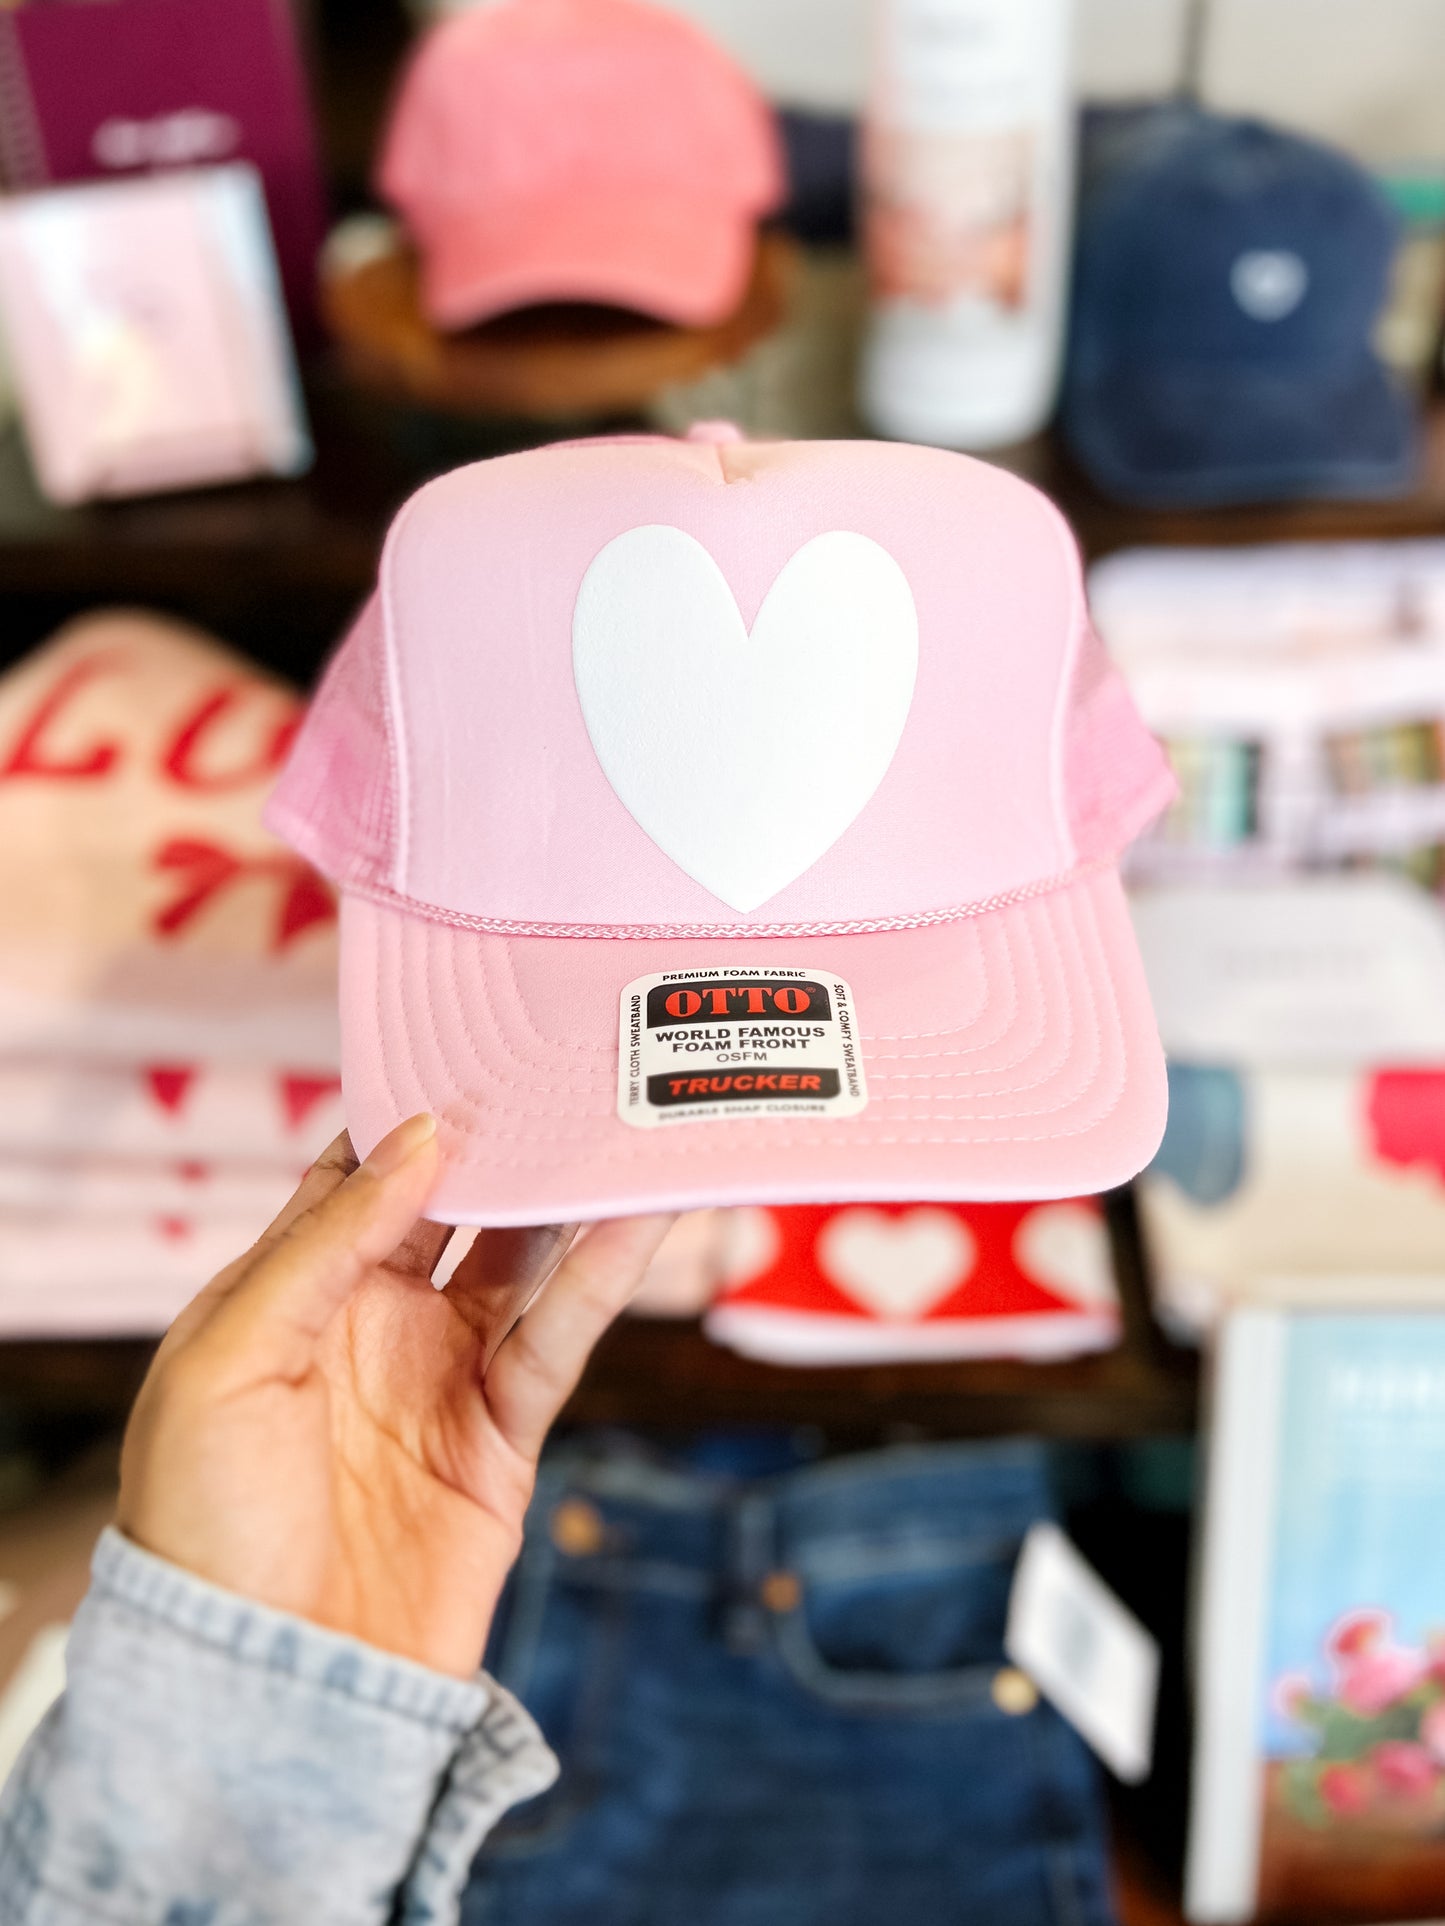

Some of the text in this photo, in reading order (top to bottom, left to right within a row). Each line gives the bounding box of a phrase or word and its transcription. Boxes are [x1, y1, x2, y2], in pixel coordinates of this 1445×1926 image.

[662, 970, 719, 981] PREMIUM
[764, 970, 806, 978] FABRIC
[833, 984, 846, 1001] SOFT
[838, 1010, 853, 1041] COMFY
[655, 1027, 826, 1042] WORLD FAMOUS
[629, 994, 641, 1107] TERRY CLOTH SWEATBAND
[672, 1039, 810, 1053] FOAM FRONT
[716, 1052, 768, 1063] OSFM
[843, 1043, 861, 1097] SWEATBAND
[668, 1075, 822, 1096] TRUCKER
[766, 1104, 827, 1113] CLOSURE
